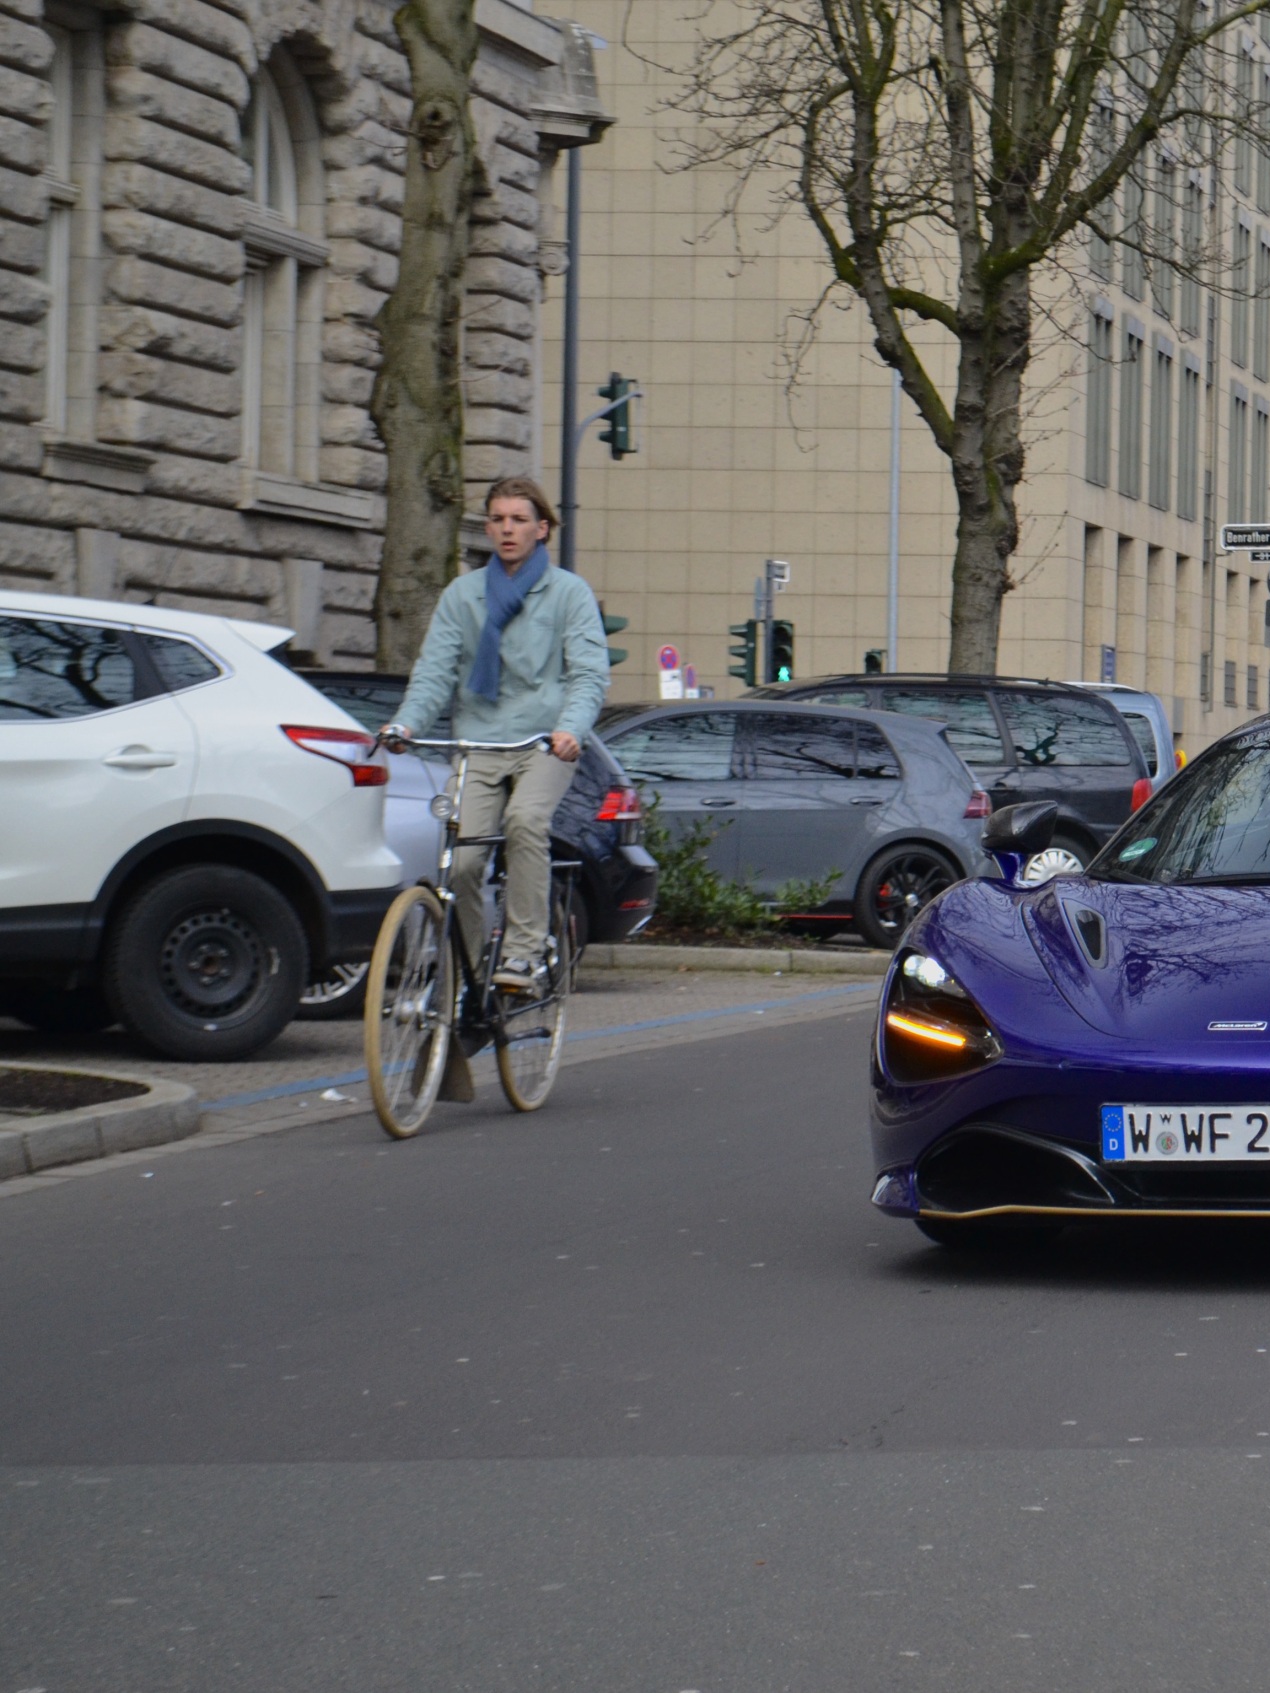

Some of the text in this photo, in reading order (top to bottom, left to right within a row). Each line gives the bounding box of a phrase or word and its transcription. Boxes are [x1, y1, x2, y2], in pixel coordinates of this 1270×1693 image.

[1227, 531, 1270, 543] Benrather
[1109, 1138, 1119, 1151] D
[1128, 1112, 1152, 1154] W
[1181, 1112, 1232, 1154] WF
